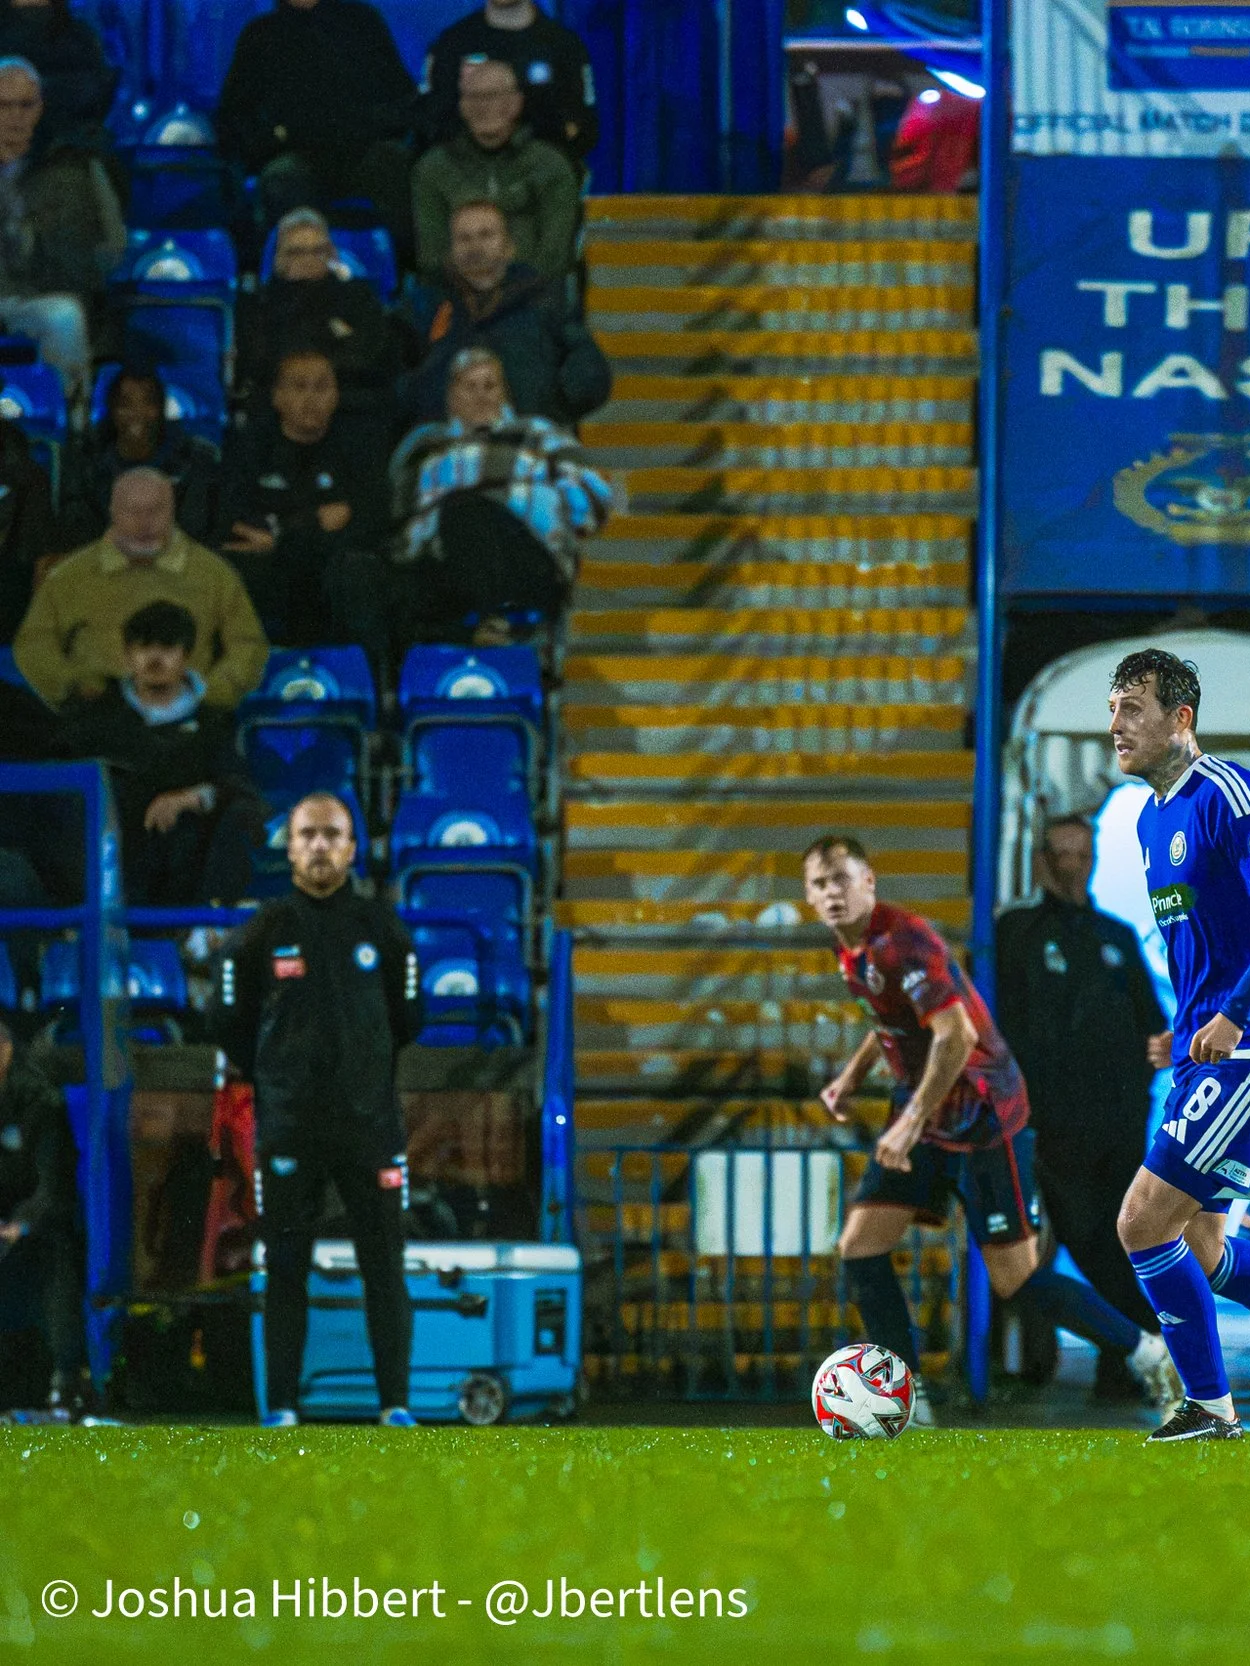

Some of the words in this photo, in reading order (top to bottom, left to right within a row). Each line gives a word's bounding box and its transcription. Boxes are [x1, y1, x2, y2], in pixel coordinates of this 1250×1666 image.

[1012, 111, 1130, 135] OFFICIAL
[1139, 110, 1231, 134] MATCH
[1182, 1076, 1222, 1122] 8
